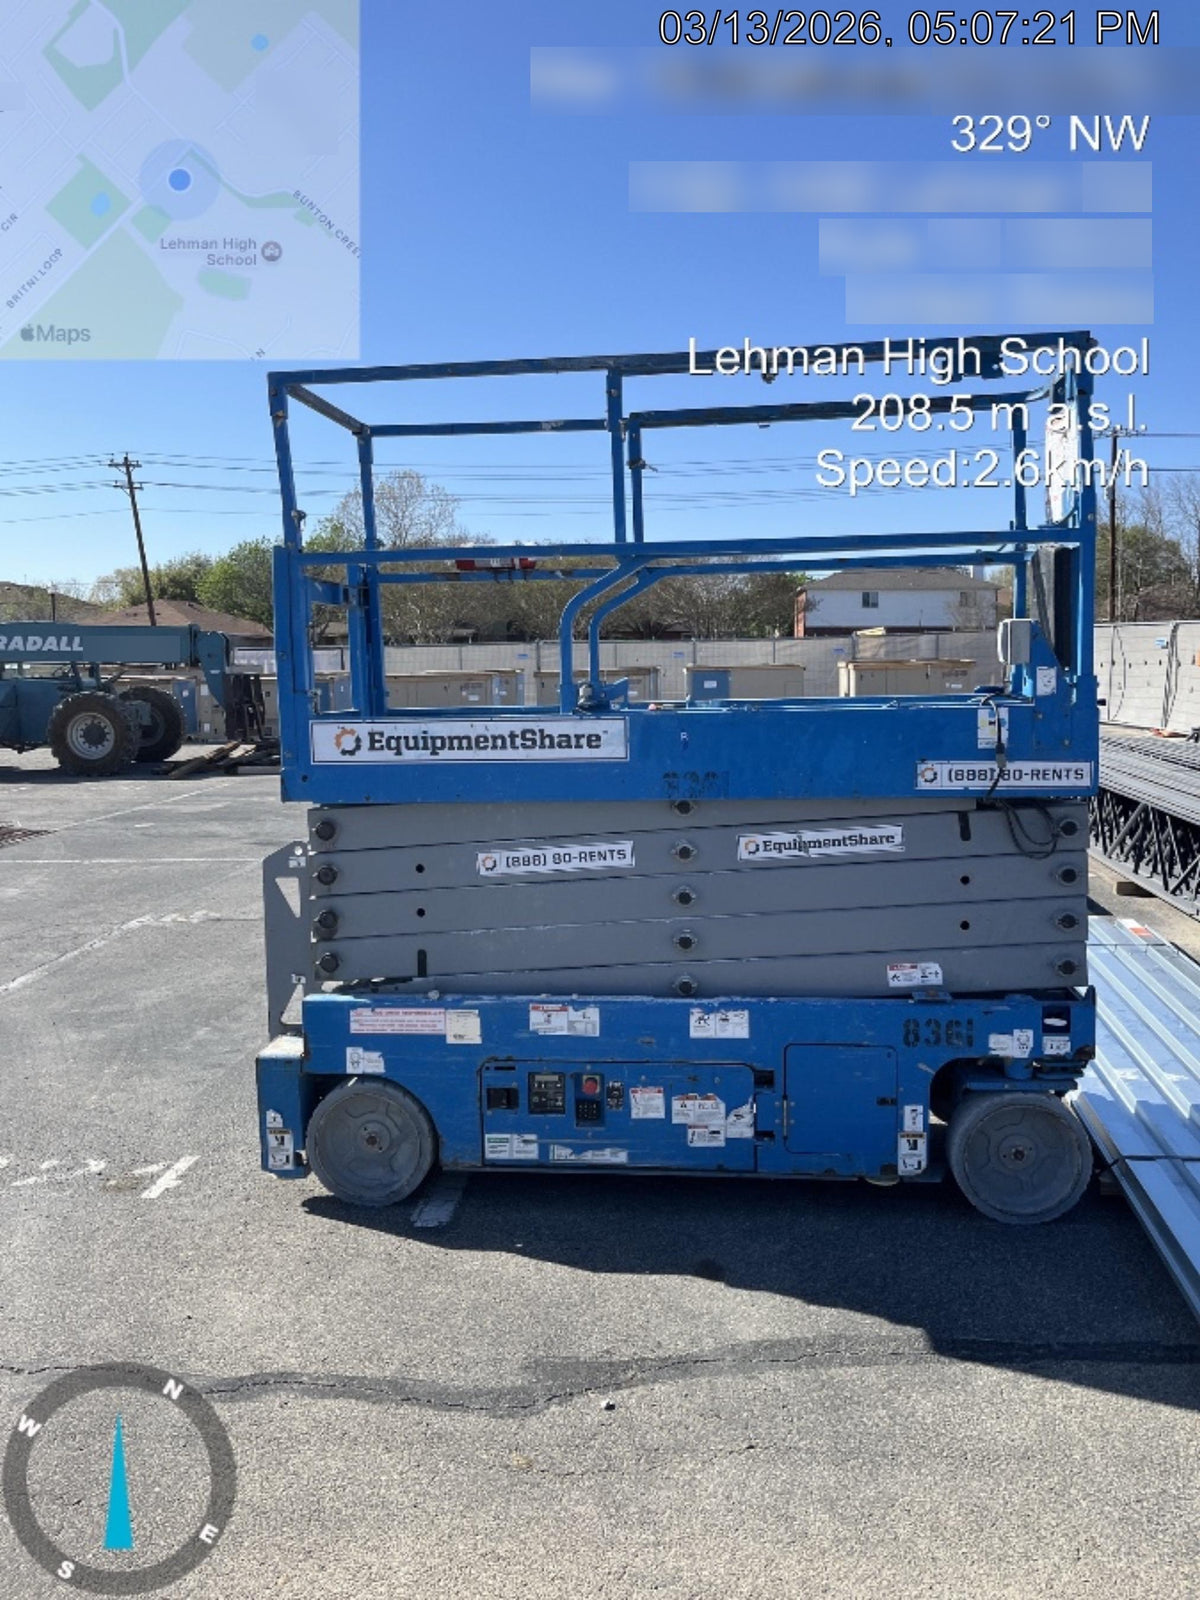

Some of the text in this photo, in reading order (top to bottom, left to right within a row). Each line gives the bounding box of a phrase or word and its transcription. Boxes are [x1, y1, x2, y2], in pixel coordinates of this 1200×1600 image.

[367, 728, 602, 757] EquipmentShare
[947, 768, 1084, 782] (888) 80-RENTS
[762, 833, 896, 855] EquipmentShare
[505, 849, 627, 869] (888) 80-RENTS
